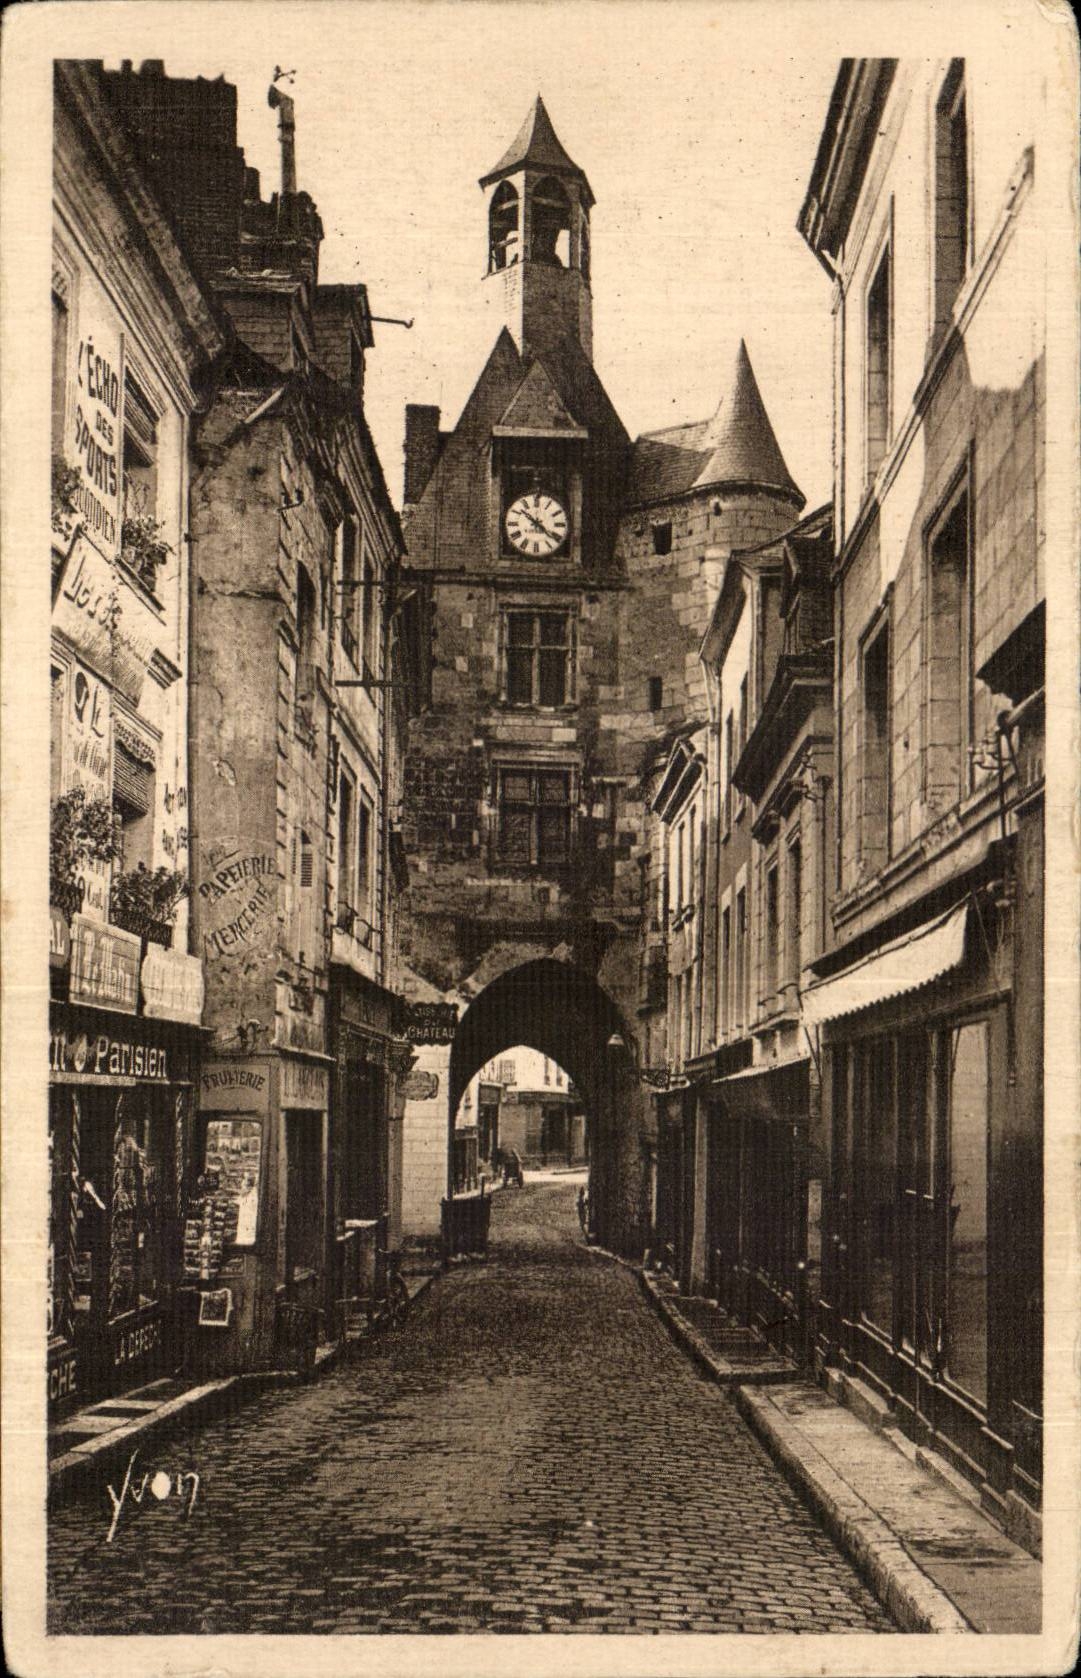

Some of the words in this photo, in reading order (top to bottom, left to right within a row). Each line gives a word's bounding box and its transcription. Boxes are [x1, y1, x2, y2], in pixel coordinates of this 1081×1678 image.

[96, 409, 113, 446] DES
[75, 404, 117, 497] SPORTS
[199, 854, 277, 899] PAPETERIE
[95, 1034, 167, 1078] Parisien
